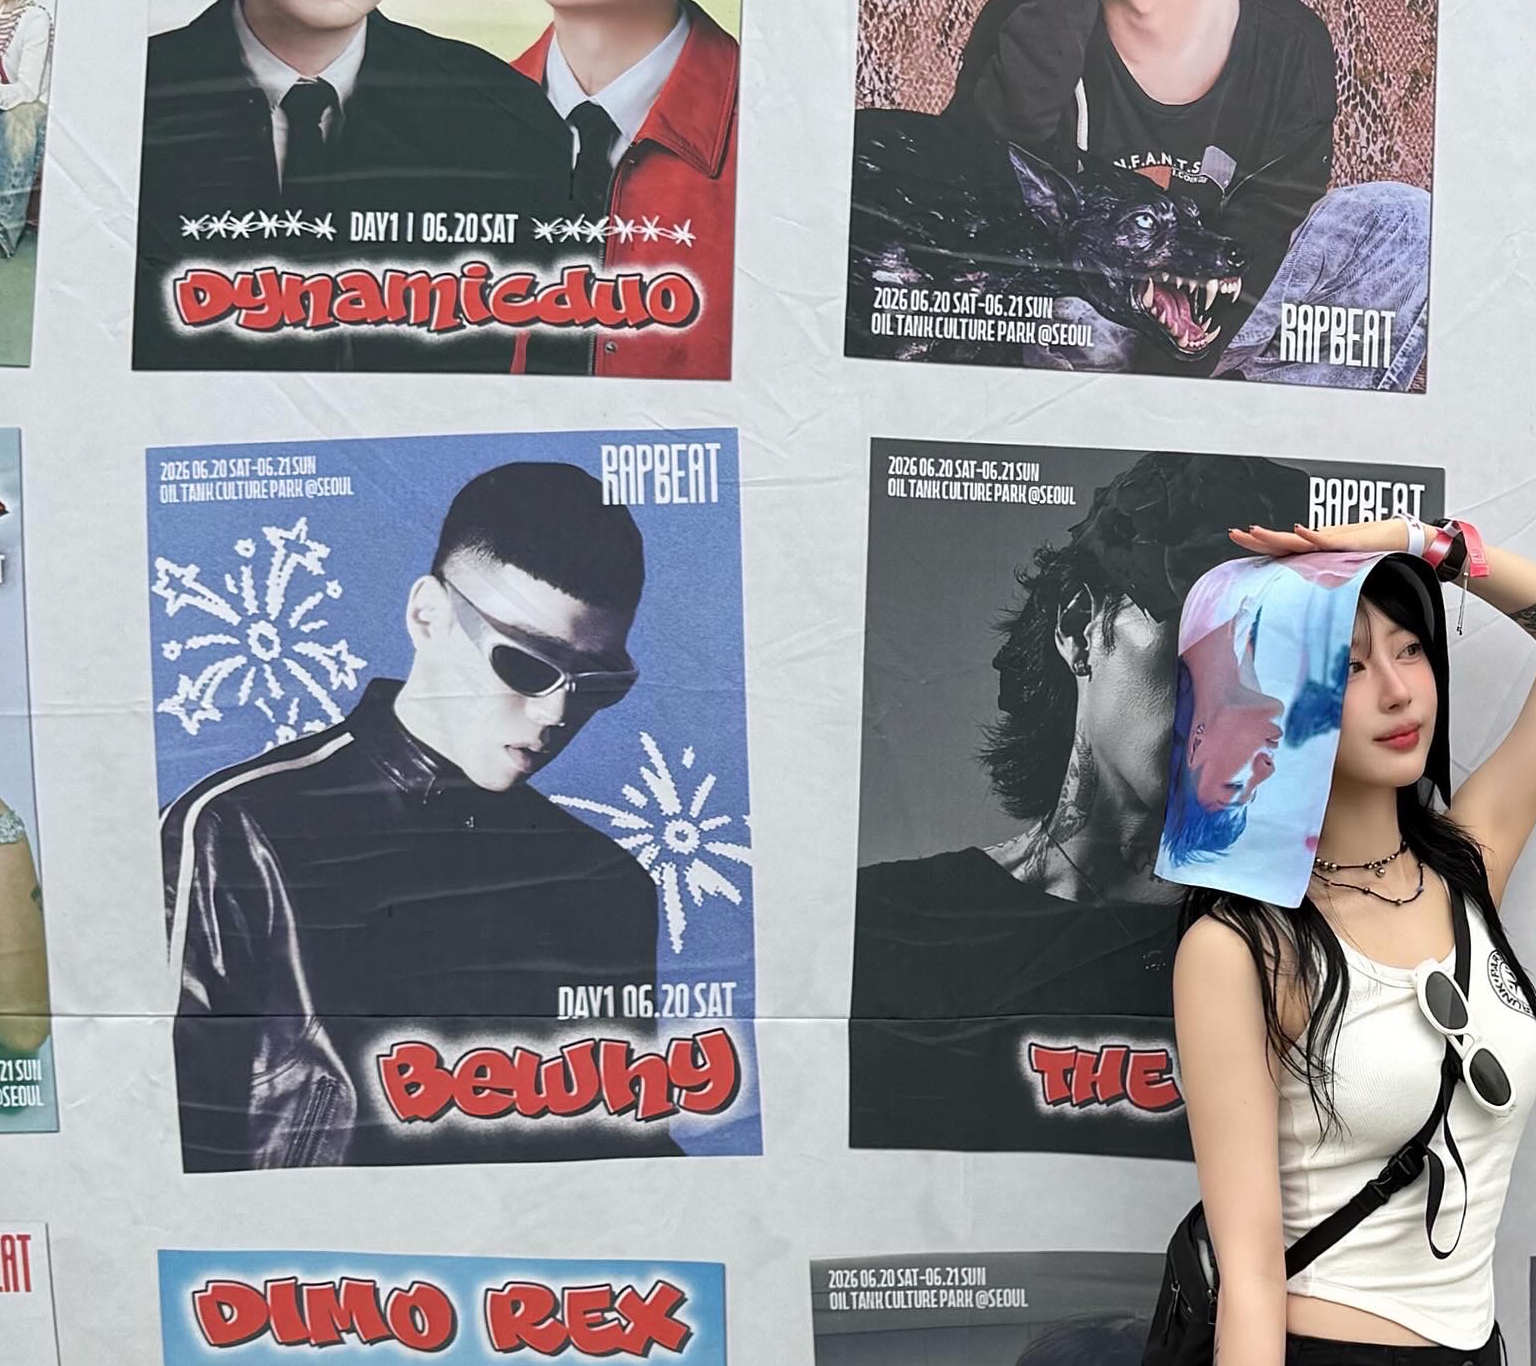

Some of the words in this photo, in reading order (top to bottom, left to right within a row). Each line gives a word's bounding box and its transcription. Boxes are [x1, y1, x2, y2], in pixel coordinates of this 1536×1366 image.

[350, 212, 399, 242] DAY1
[421, 213, 479, 244] 06.20
[480, 213, 519, 244] SAT
[1280, 302, 1396, 369] RAPBEAT
[601, 443, 721, 505] RAPBEAT
[557, 985, 615, 1021] DAY1
[623, 982, 690, 1019] 06.20
[693, 981, 737, 1018] SAT
[1028, 1042, 1185, 1113] THE
[192, 1276, 458, 1353] DIMO
[485, 1279, 695, 1358] REX
